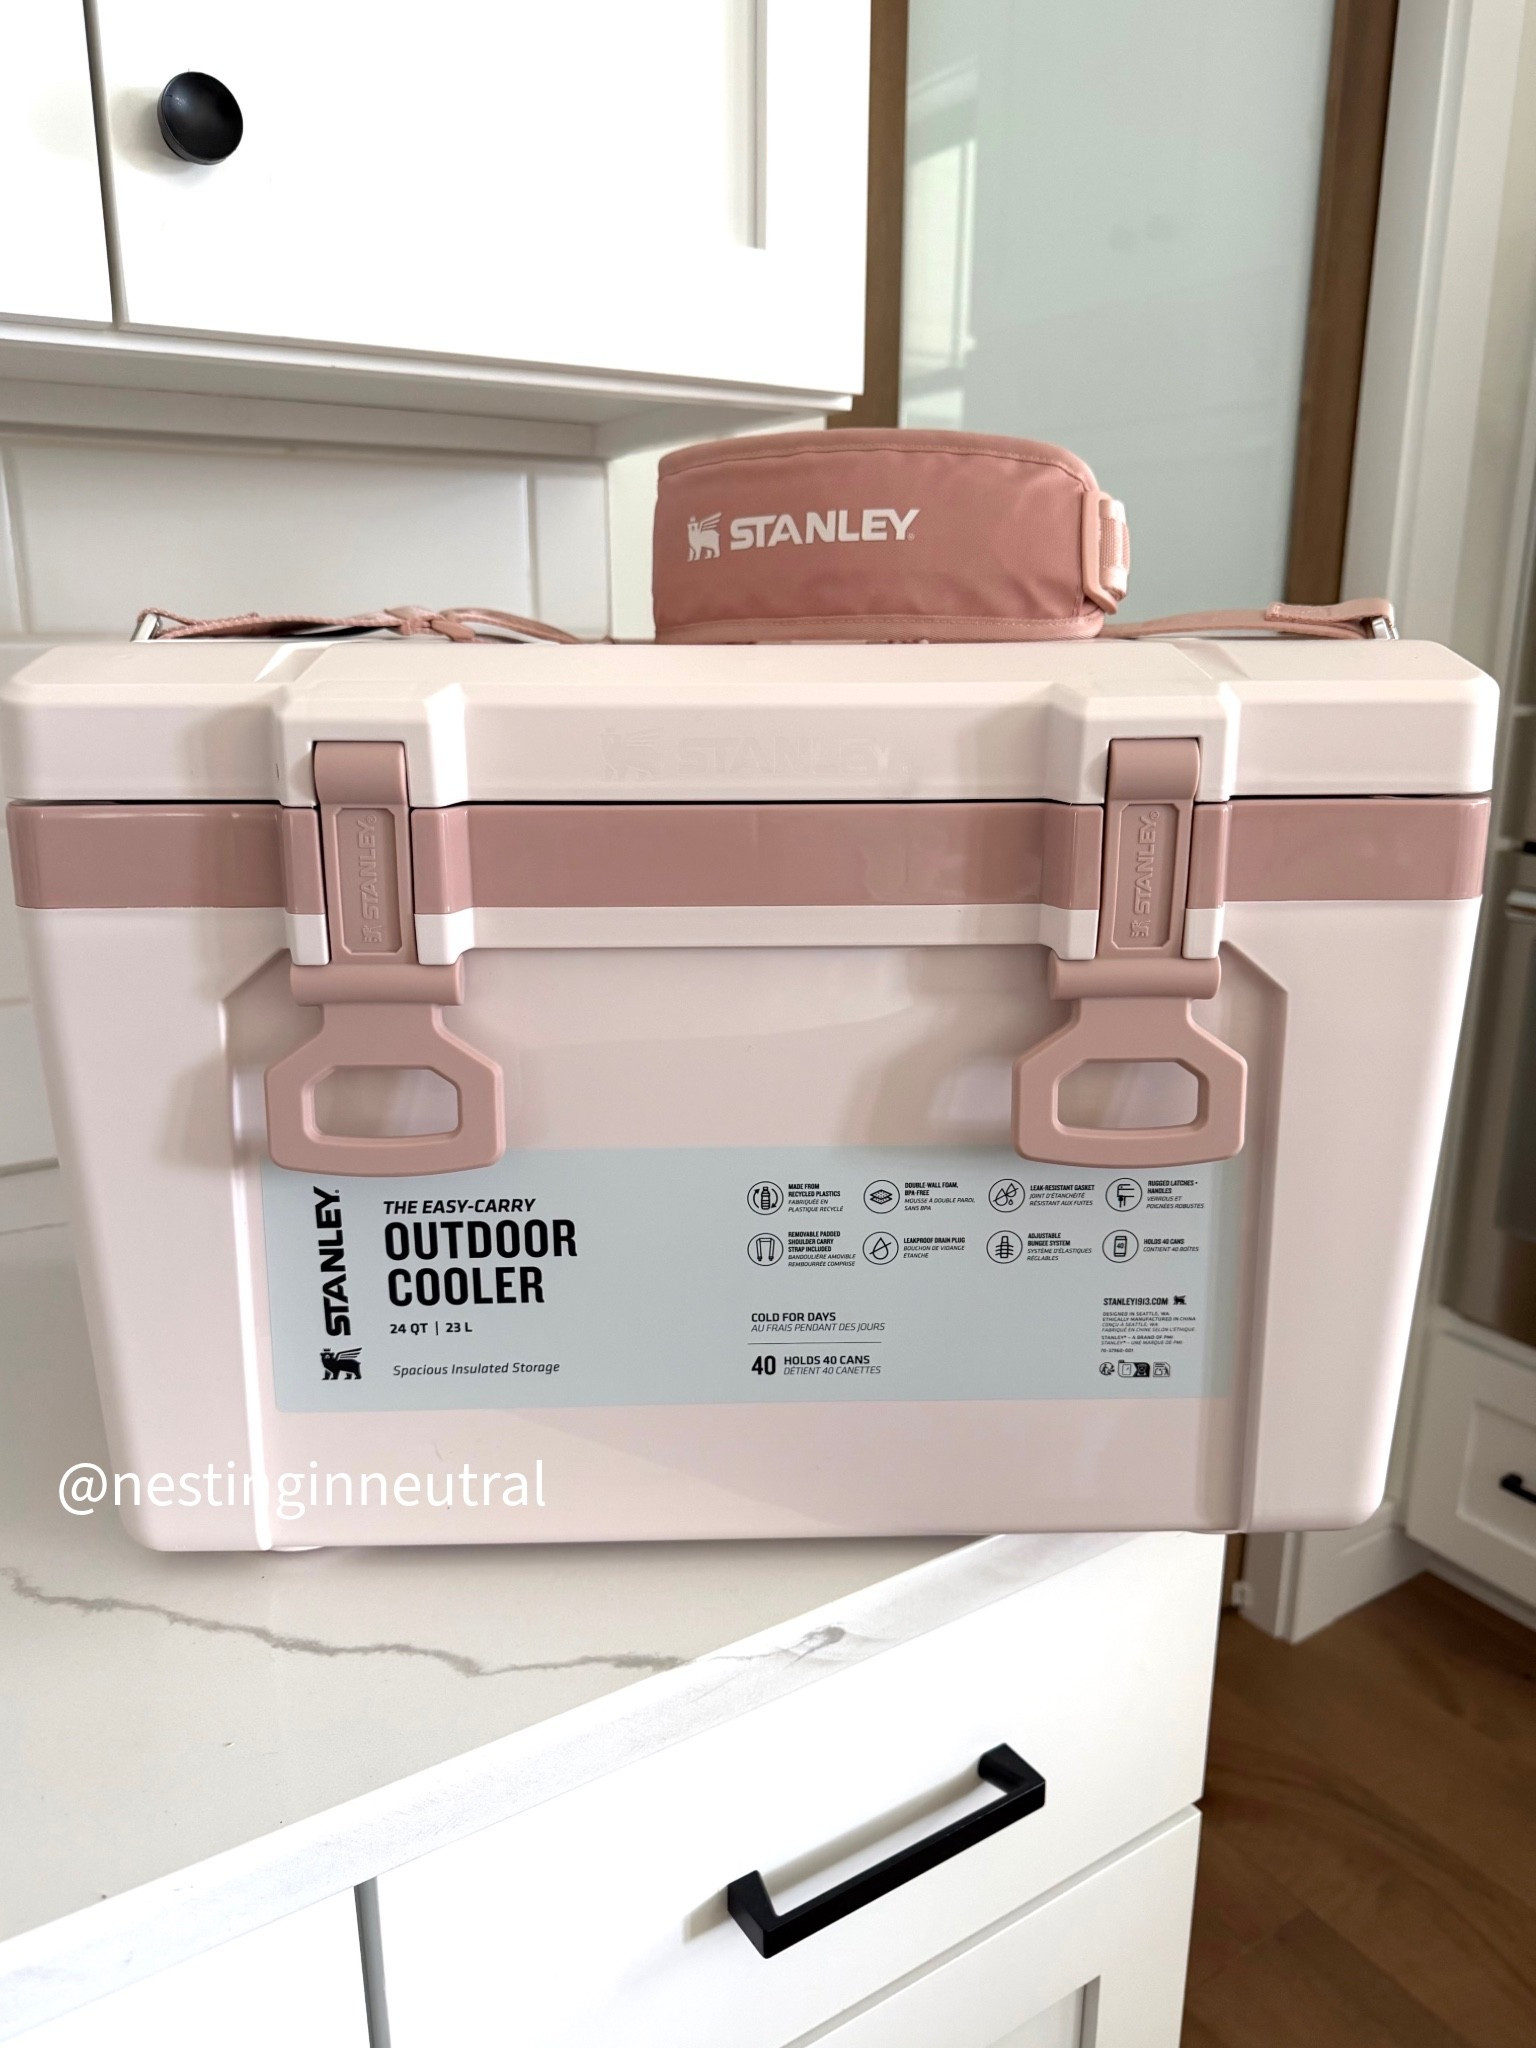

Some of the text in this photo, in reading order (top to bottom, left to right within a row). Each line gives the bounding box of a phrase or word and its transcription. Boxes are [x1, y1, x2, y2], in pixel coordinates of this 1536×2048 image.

[730, 508, 919, 551] STANLEY
[384, 1198, 536, 1214] THE EASY-CARRY
[384, 1219, 577, 1261] OUTDOOR
[313, 1186, 351, 1336] STANLEY
[388, 1266, 544, 1306] COOLER
[751, 1312, 836, 1322] COLD FOR DAYS
[389, 1323, 407, 1334] 24
[411, 1322, 428, 1335] QT
[445, 1322, 461, 1333] 23
[464, 1322, 473, 1333] L
[751, 1323, 885, 1332] AU FRAIS PENDANT DES JOURS
[752, 1355, 776, 1375] 40
[784, 1355, 870, 1365] HOLDS 40 CANS
[393, 1361, 560, 1378] Spacious Insulated Storage
[784, 1366, 820, 1375] DÉTIENT
[836, 1366, 881, 1374] CANETTES
